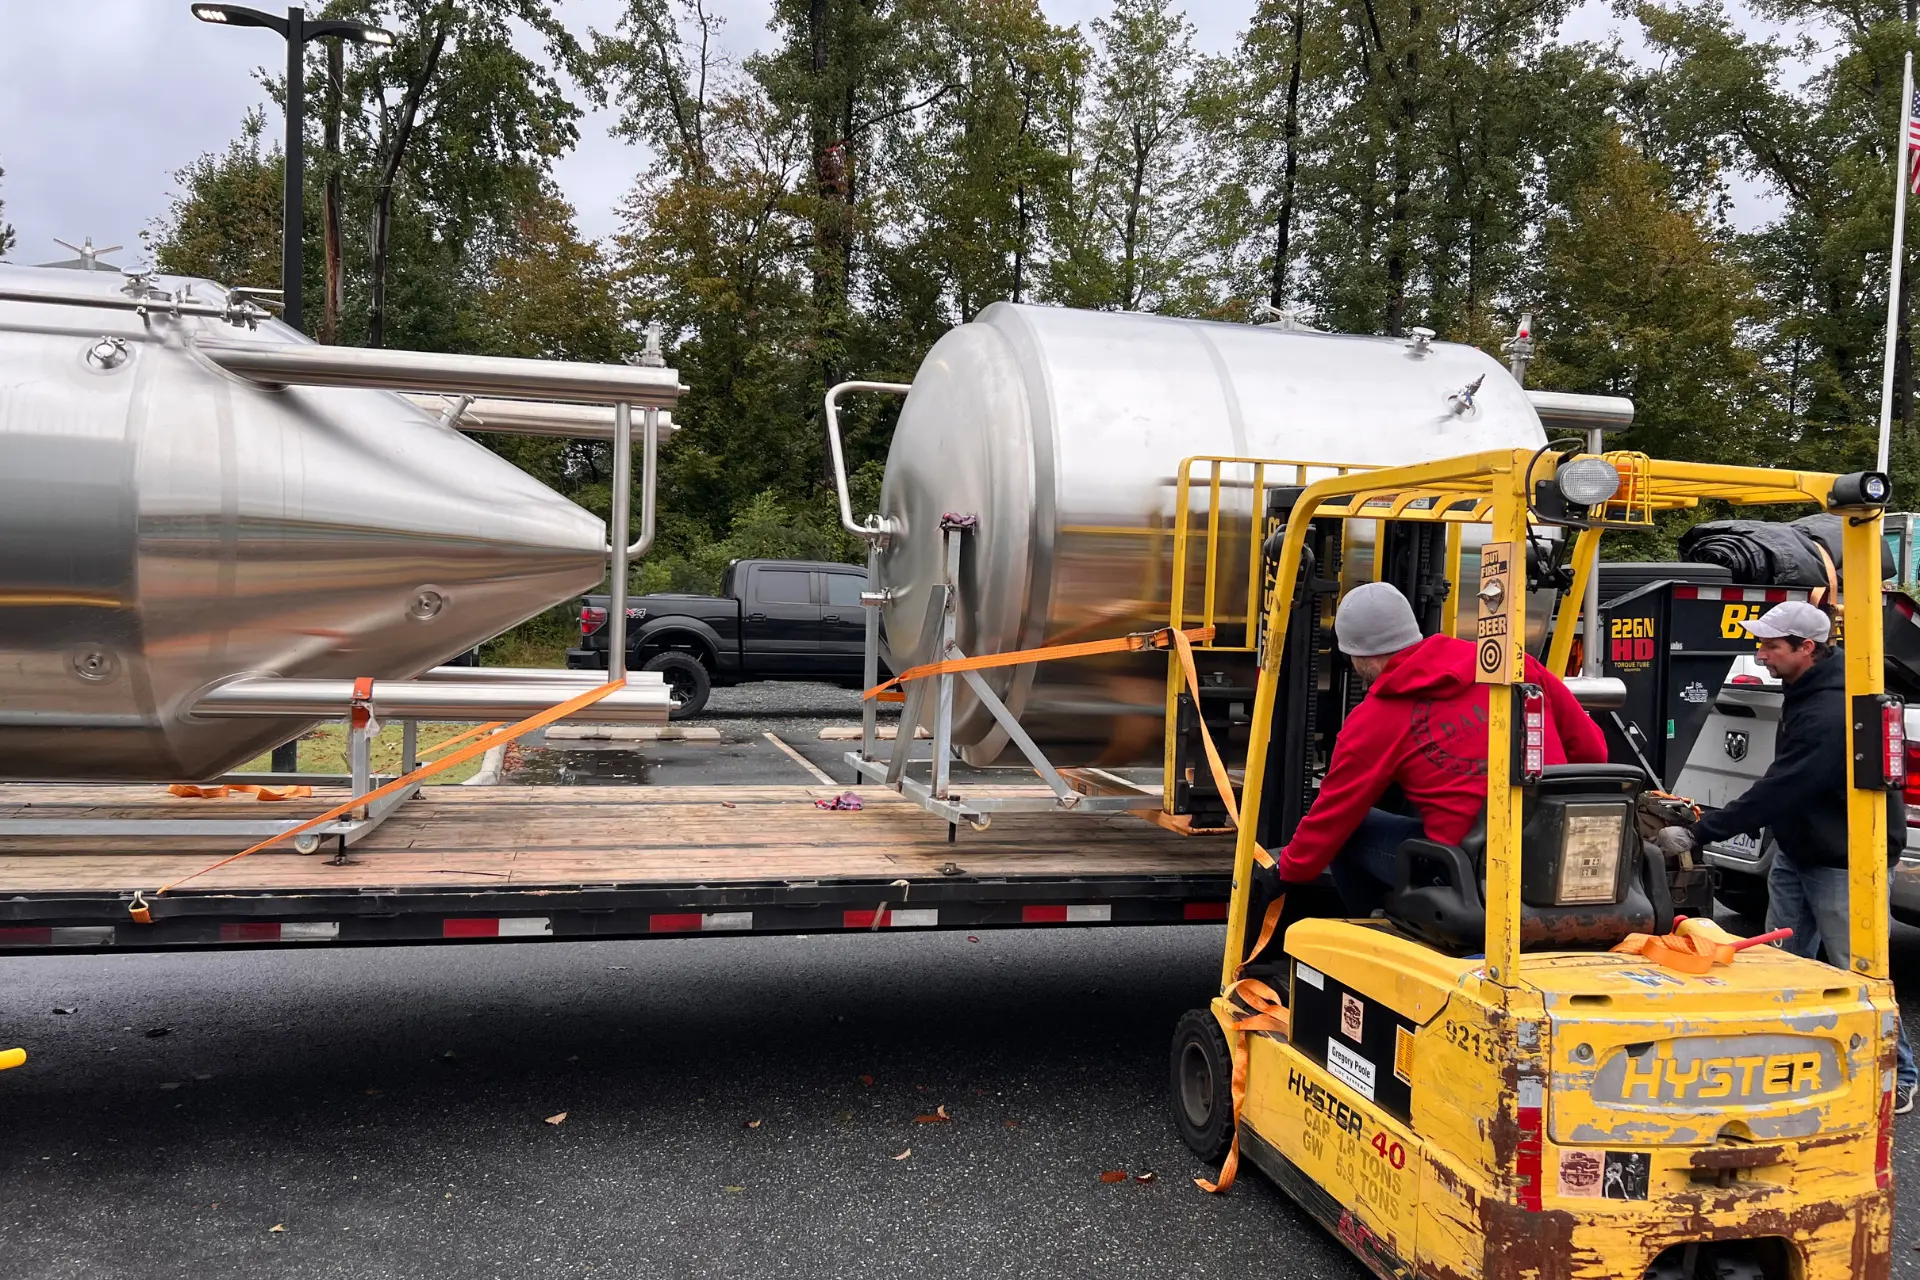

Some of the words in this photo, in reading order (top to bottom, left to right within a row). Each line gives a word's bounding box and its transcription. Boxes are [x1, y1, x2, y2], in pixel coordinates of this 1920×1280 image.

[1485, 551, 1499, 566] BUT
[1478, 615, 1507, 637] BEER
[1611, 618, 1655, 638] 22GN
[1611, 638, 1655, 661] HD
[1614, 661, 1636, 669] TORQUE
[1332, 1046, 1353, 1069] Gregory
[1354, 1060, 1371, 1079] Poole
[1620, 1051, 1823, 1099] HYSTER
[1288, 1067, 1362, 1141] HYSTER
[1371, 1132, 1406, 1169] 40
[1304, 1107, 1330, 1138] CAP
[1338, 1131, 1356, 1158] 1.8
[1360, 1146, 1402, 1195] TONS
[1302, 1129, 1323, 1160] GW
[1359, 1170, 1399, 1221] TONS
